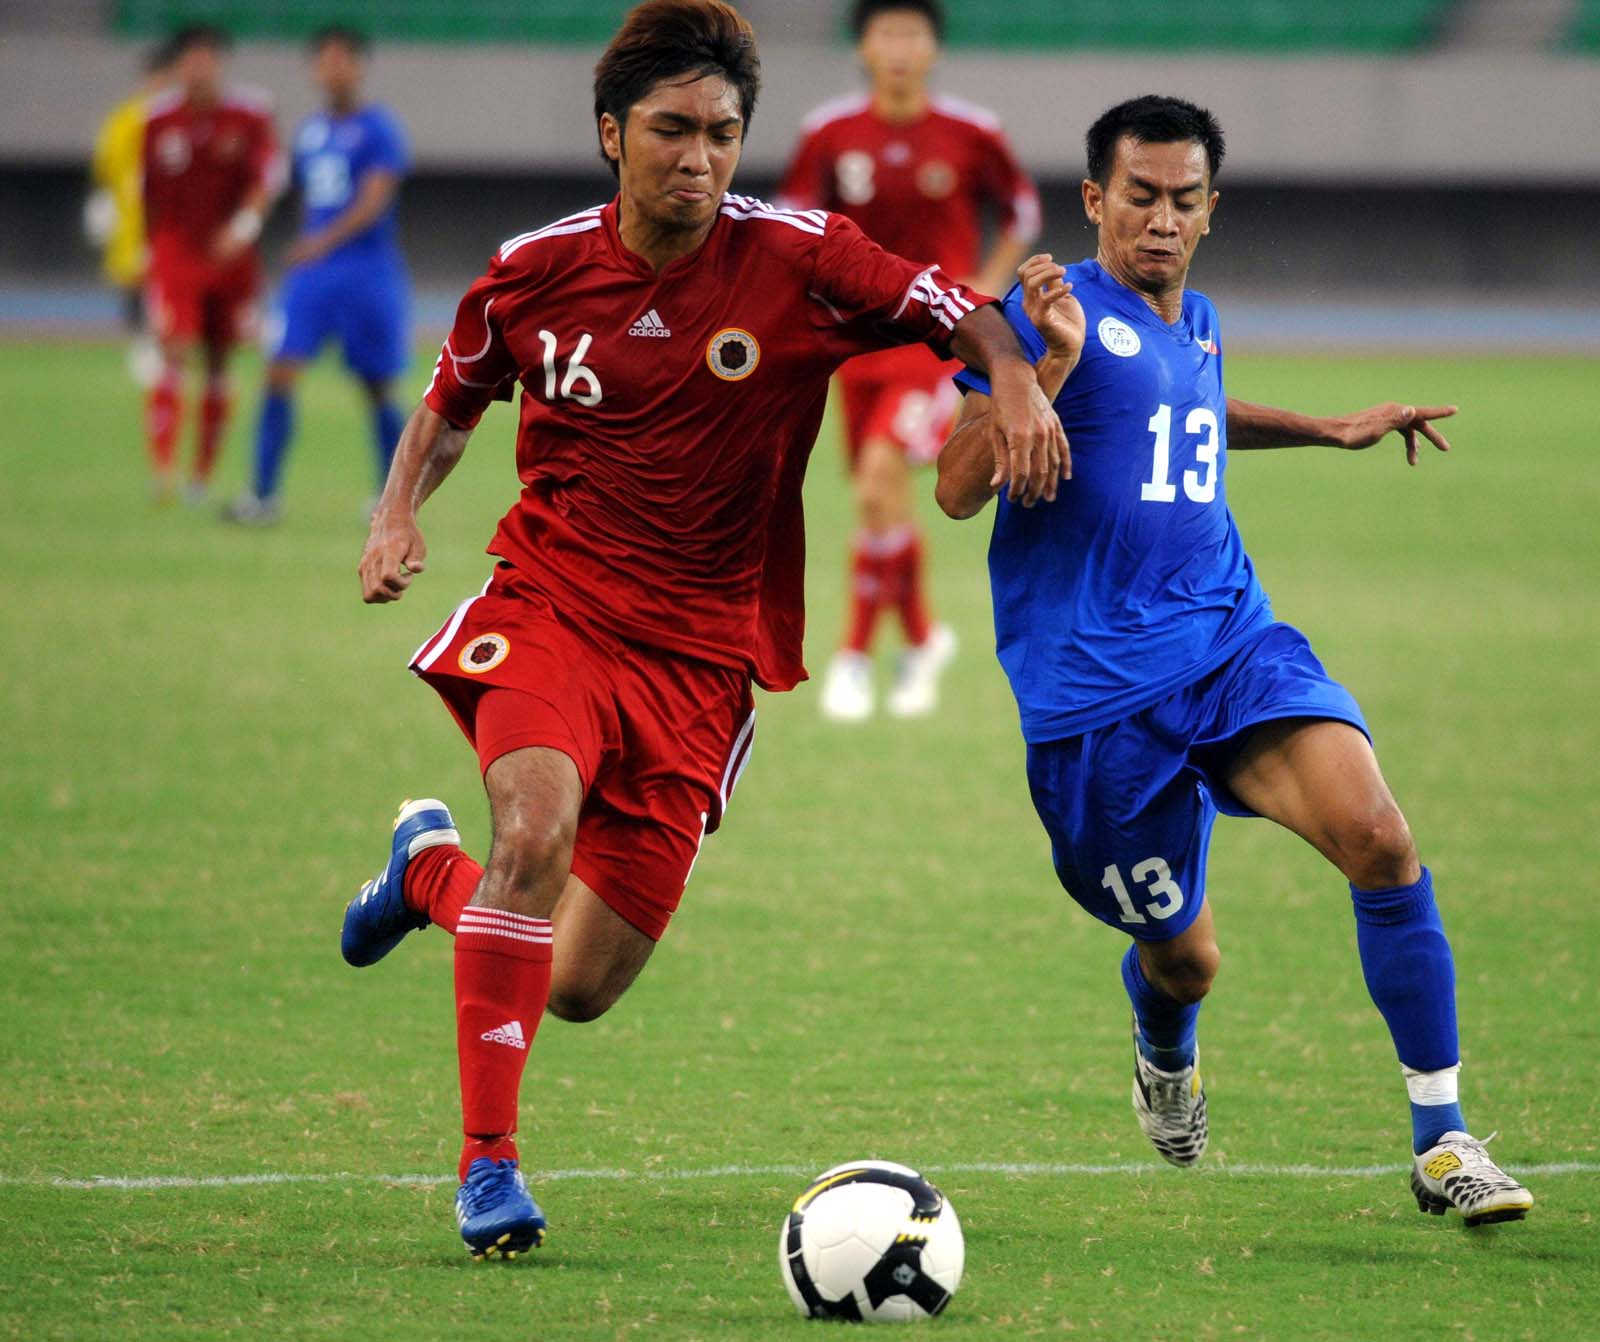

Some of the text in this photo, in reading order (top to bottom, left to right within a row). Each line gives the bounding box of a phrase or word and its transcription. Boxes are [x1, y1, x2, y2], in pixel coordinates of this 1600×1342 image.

[628, 326, 671, 337] adidas
[538, 330, 602, 407] 16
[1141, 403, 1218, 503] 13
[1101, 857, 1184, 924] 13
[480, 1030, 525, 1049] adidas
